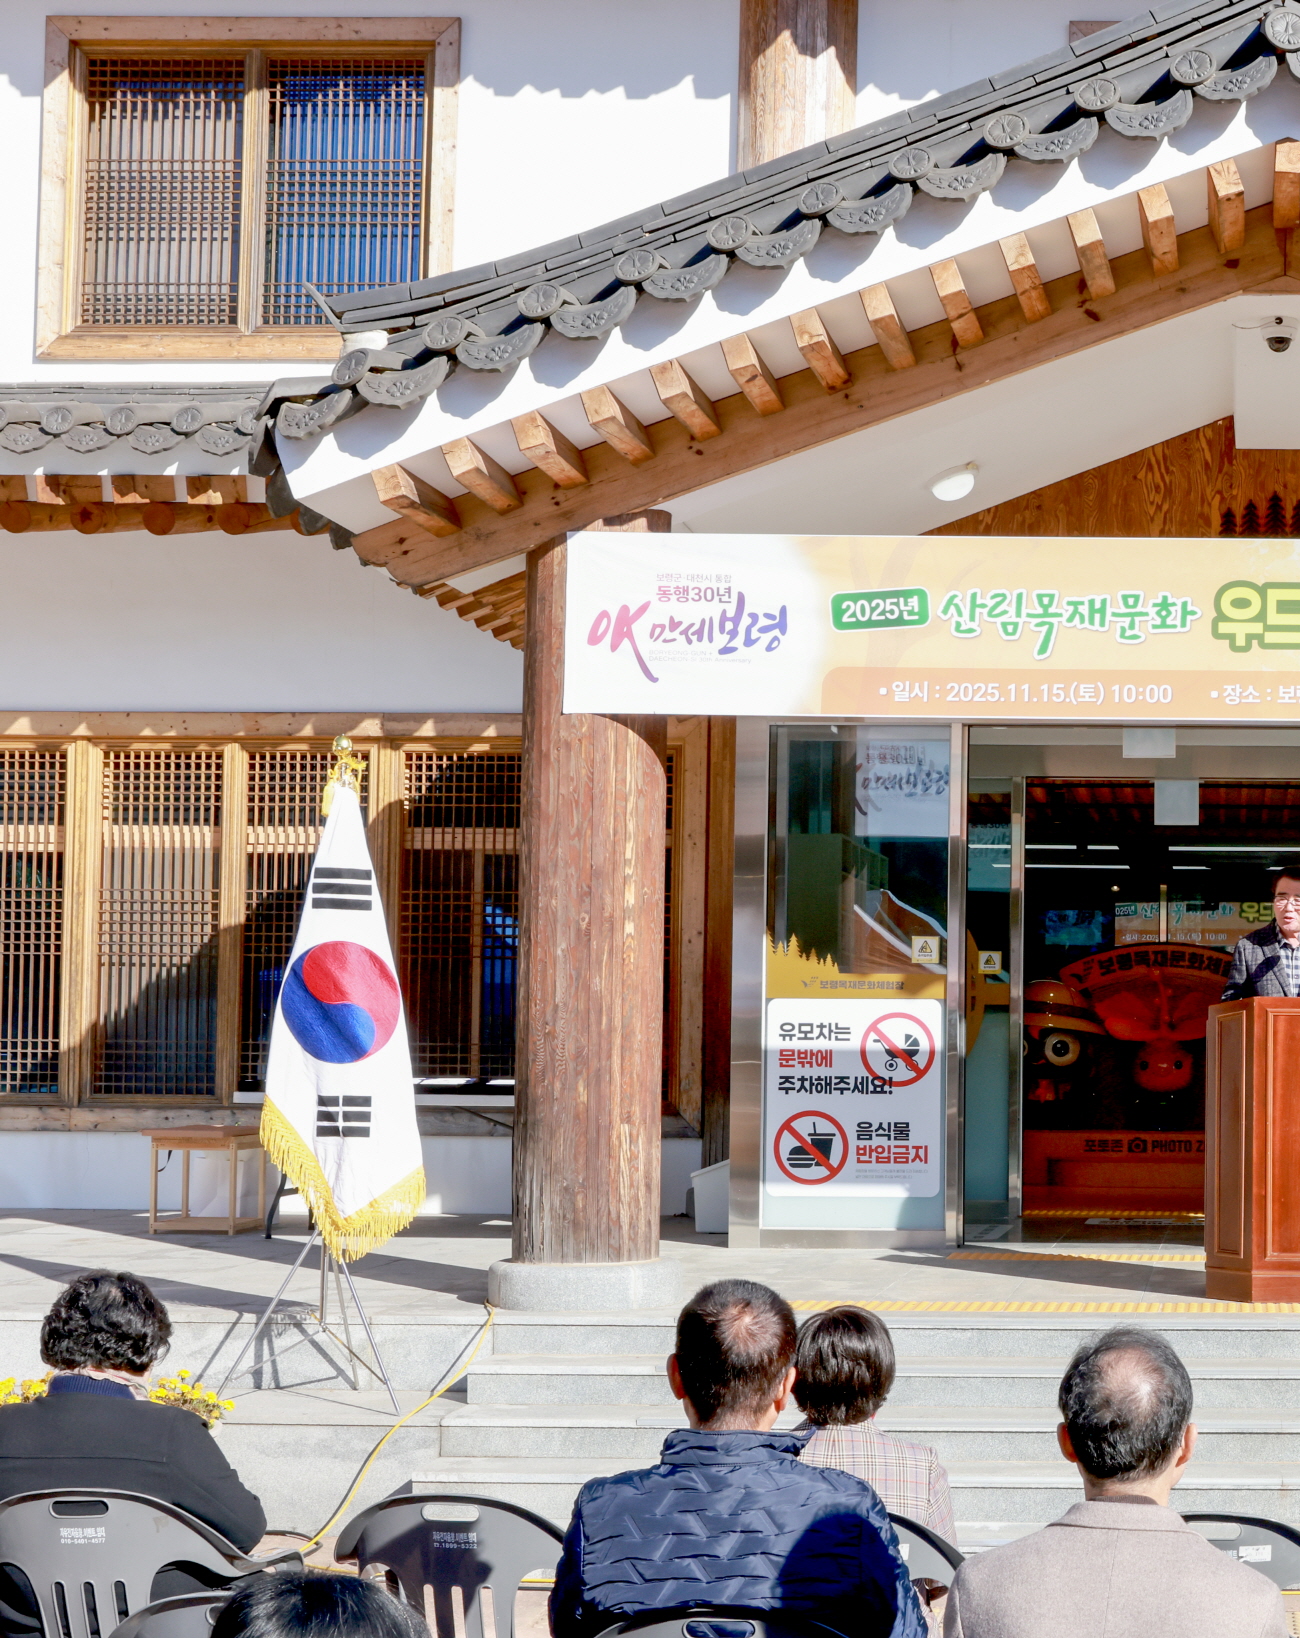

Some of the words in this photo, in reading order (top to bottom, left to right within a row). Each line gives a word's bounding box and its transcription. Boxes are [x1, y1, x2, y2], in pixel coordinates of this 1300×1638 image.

[714, 573, 733, 583] 통합
[655, 585, 733, 604] 동행30년
[840, 595, 921, 623] 2025년
[939, 590, 1200, 658] 산림목재문화
[586, 600, 660, 684] OK
[648, 590, 789, 656] 만세보령
[714, 657, 752, 665] Anniversary
[891, 681, 929, 702] 일시
[945, 681, 1105, 706] 2025.11.15.(토)
[1111, 683, 1173, 704] 10:00
[1222, 684, 1260, 705] 장소
[819, 979, 905, 991] 보령목재문화체험장
[778, 1021, 852, 1042] 유모차는
[778, 1049, 833, 1068] 문밖에
[777, 1075, 894, 1096] 주차해주세요!
[855, 1121, 911, 1142] 음식물
[855, 1144, 929, 1165] 반입금지
[1083, 1139, 1124, 1153] 포토존
[1151, 1139, 1193, 1153] PHOTO
